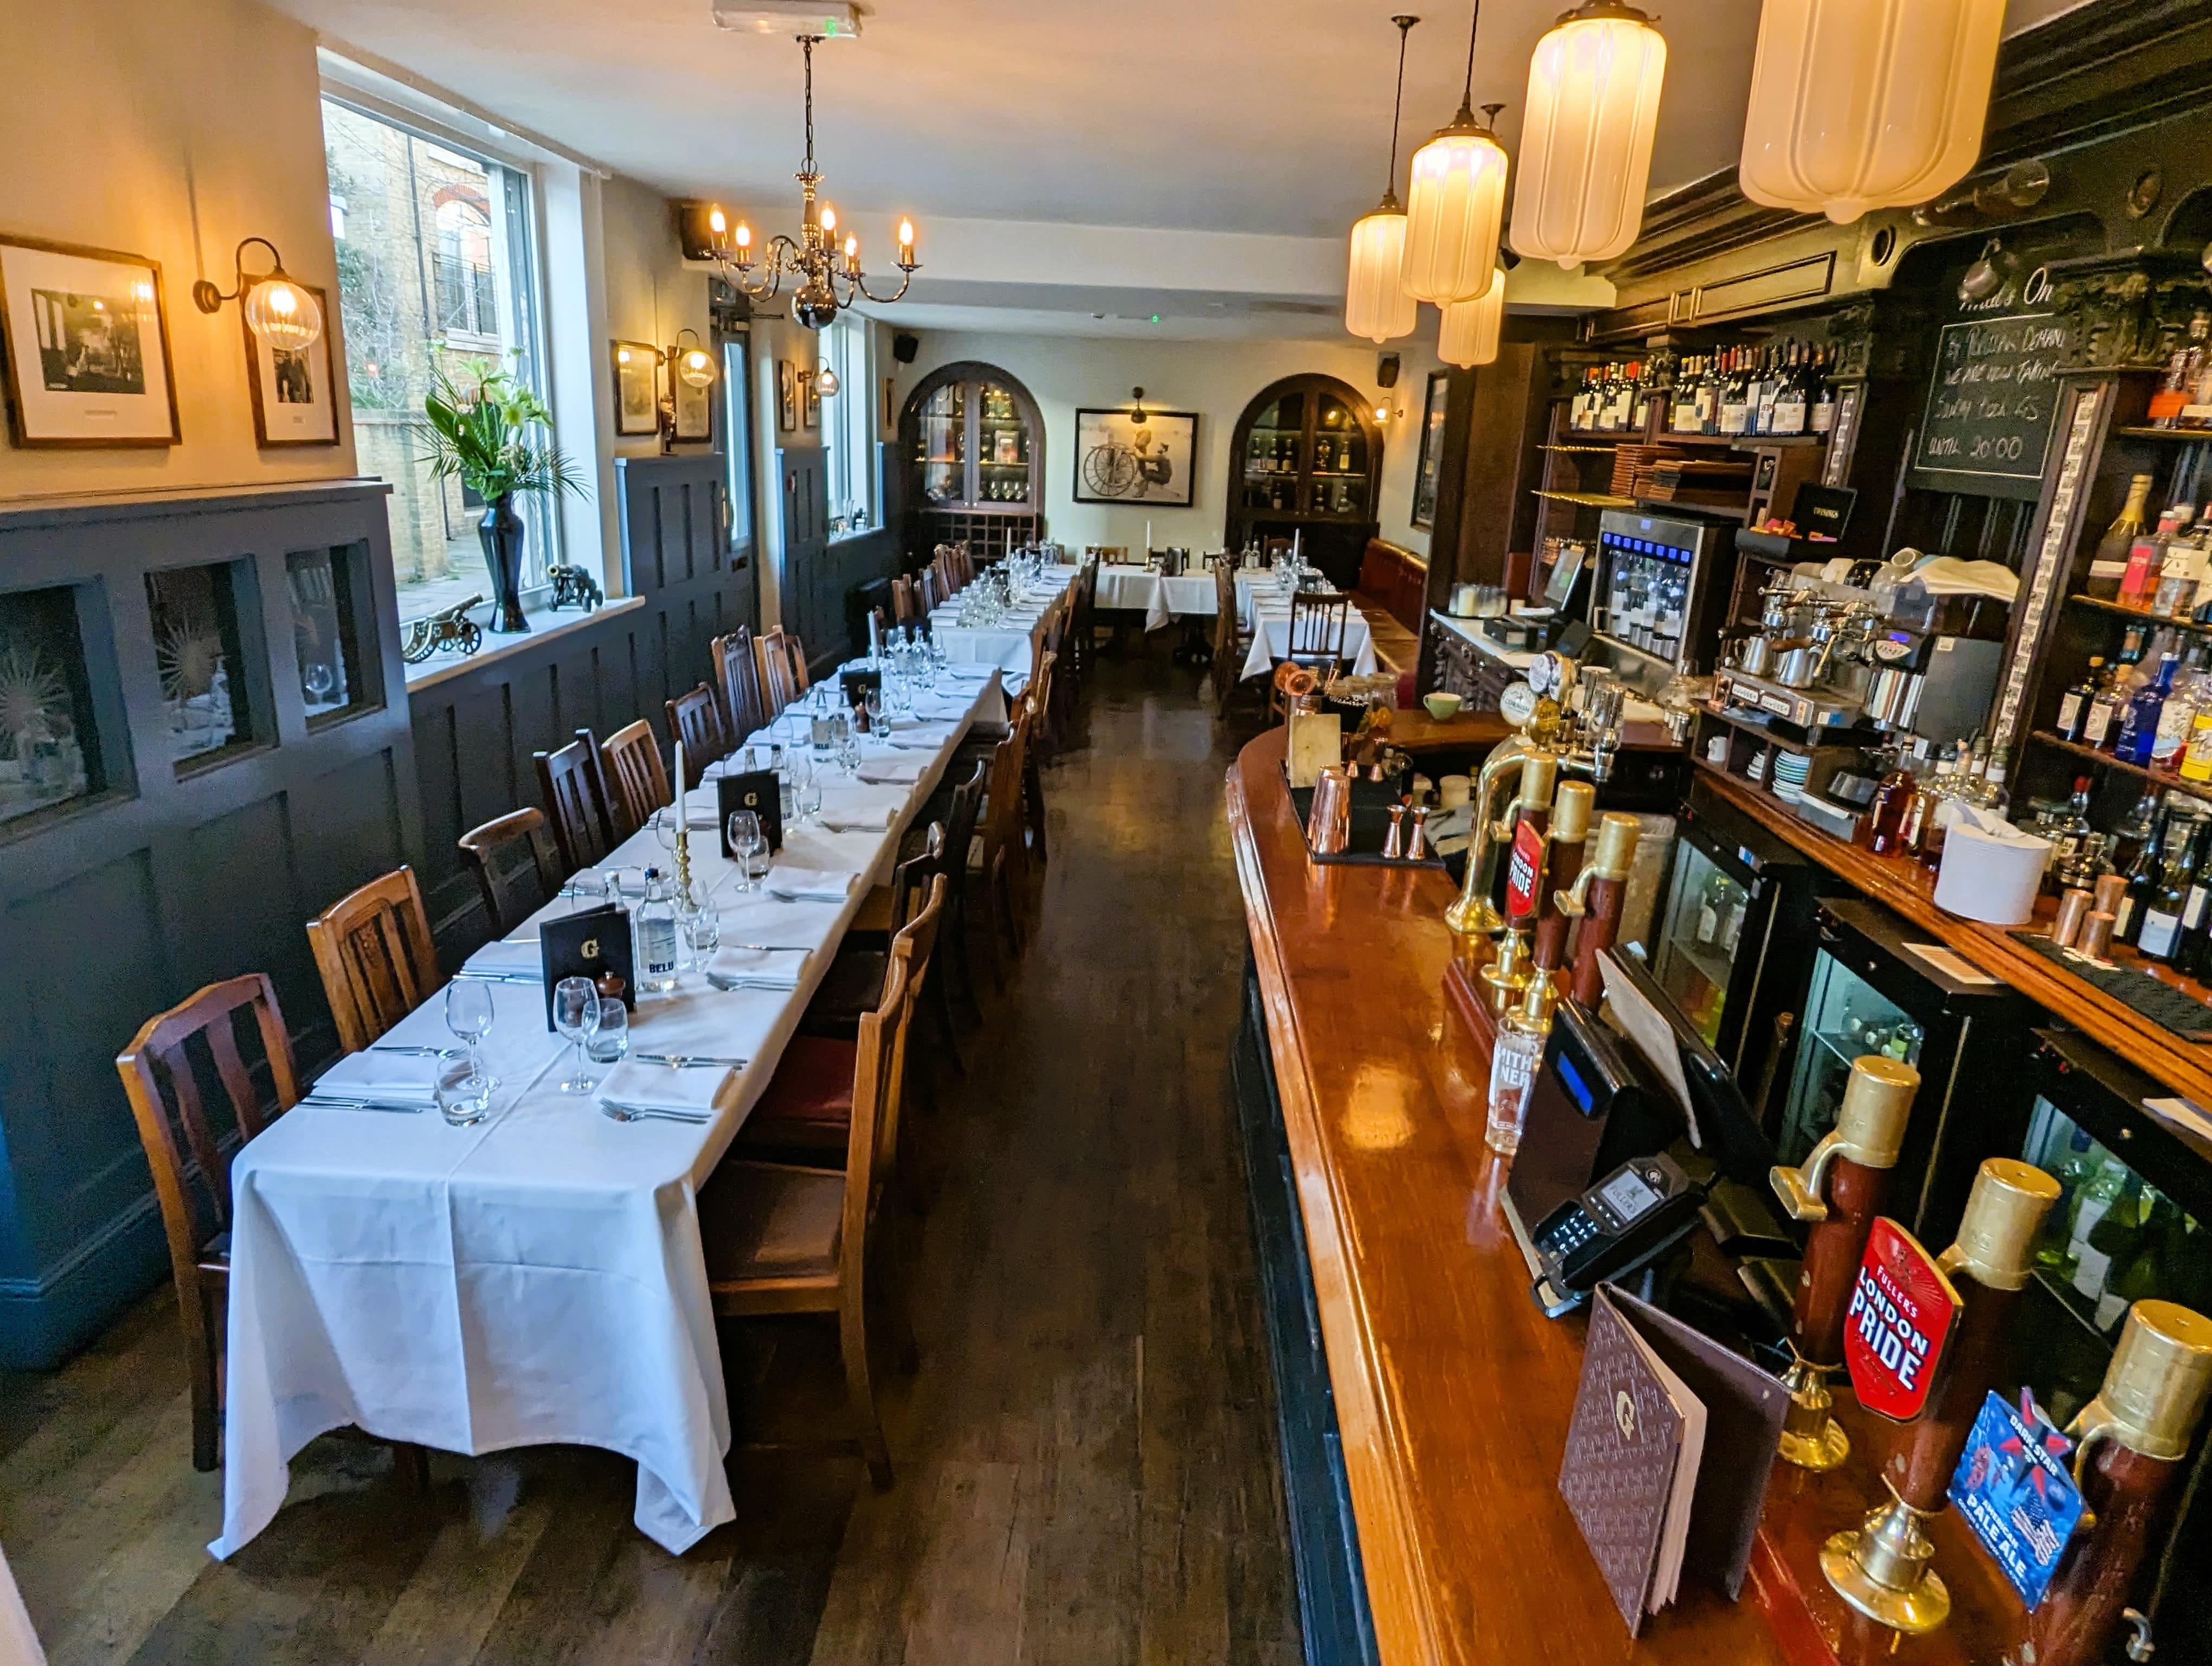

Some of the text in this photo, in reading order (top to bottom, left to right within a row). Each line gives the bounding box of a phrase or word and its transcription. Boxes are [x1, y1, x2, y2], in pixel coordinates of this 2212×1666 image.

[2023, 267, 2055, 305] On
[744, 792, 757, 806] G
[581, 939, 600, 958] G
[649, 960, 674, 973] BELU
[1859, 1266, 1928, 1356] LONDON
[1876, 1265, 1918, 1318] FULLER'S
[1849, 1286, 1922, 1391] PRIDE
[2010, 1414, 2036, 1449] DARK
[2033, 1444, 2058, 1477] STAR
[1966, 1493, 2001, 1542] PALE
[1998, 1540, 2027, 1579] ALE
[1982, 1499, 2019, 1549] AMERICAN
